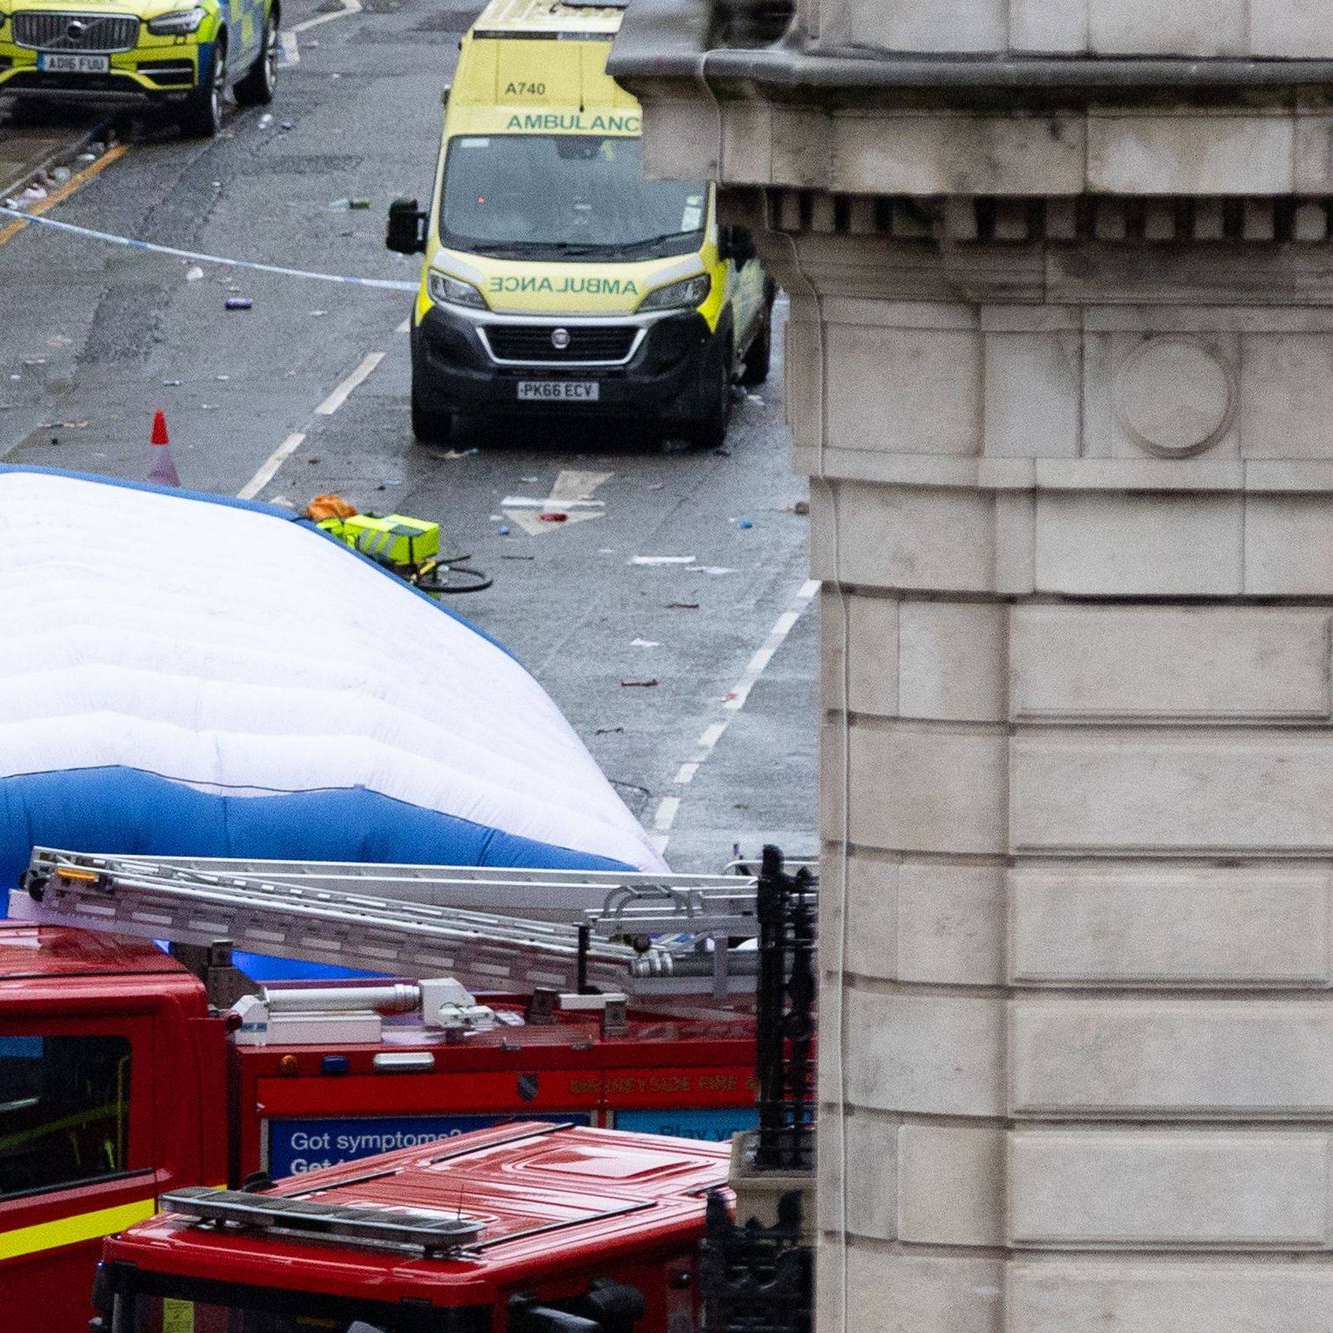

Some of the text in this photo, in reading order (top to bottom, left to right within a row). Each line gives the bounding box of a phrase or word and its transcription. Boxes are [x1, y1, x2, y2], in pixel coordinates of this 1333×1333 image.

[505, 82, 546, 95] A740
[523, 384, 561, 397] PK66
[291, 1132, 330, 1150] Got
